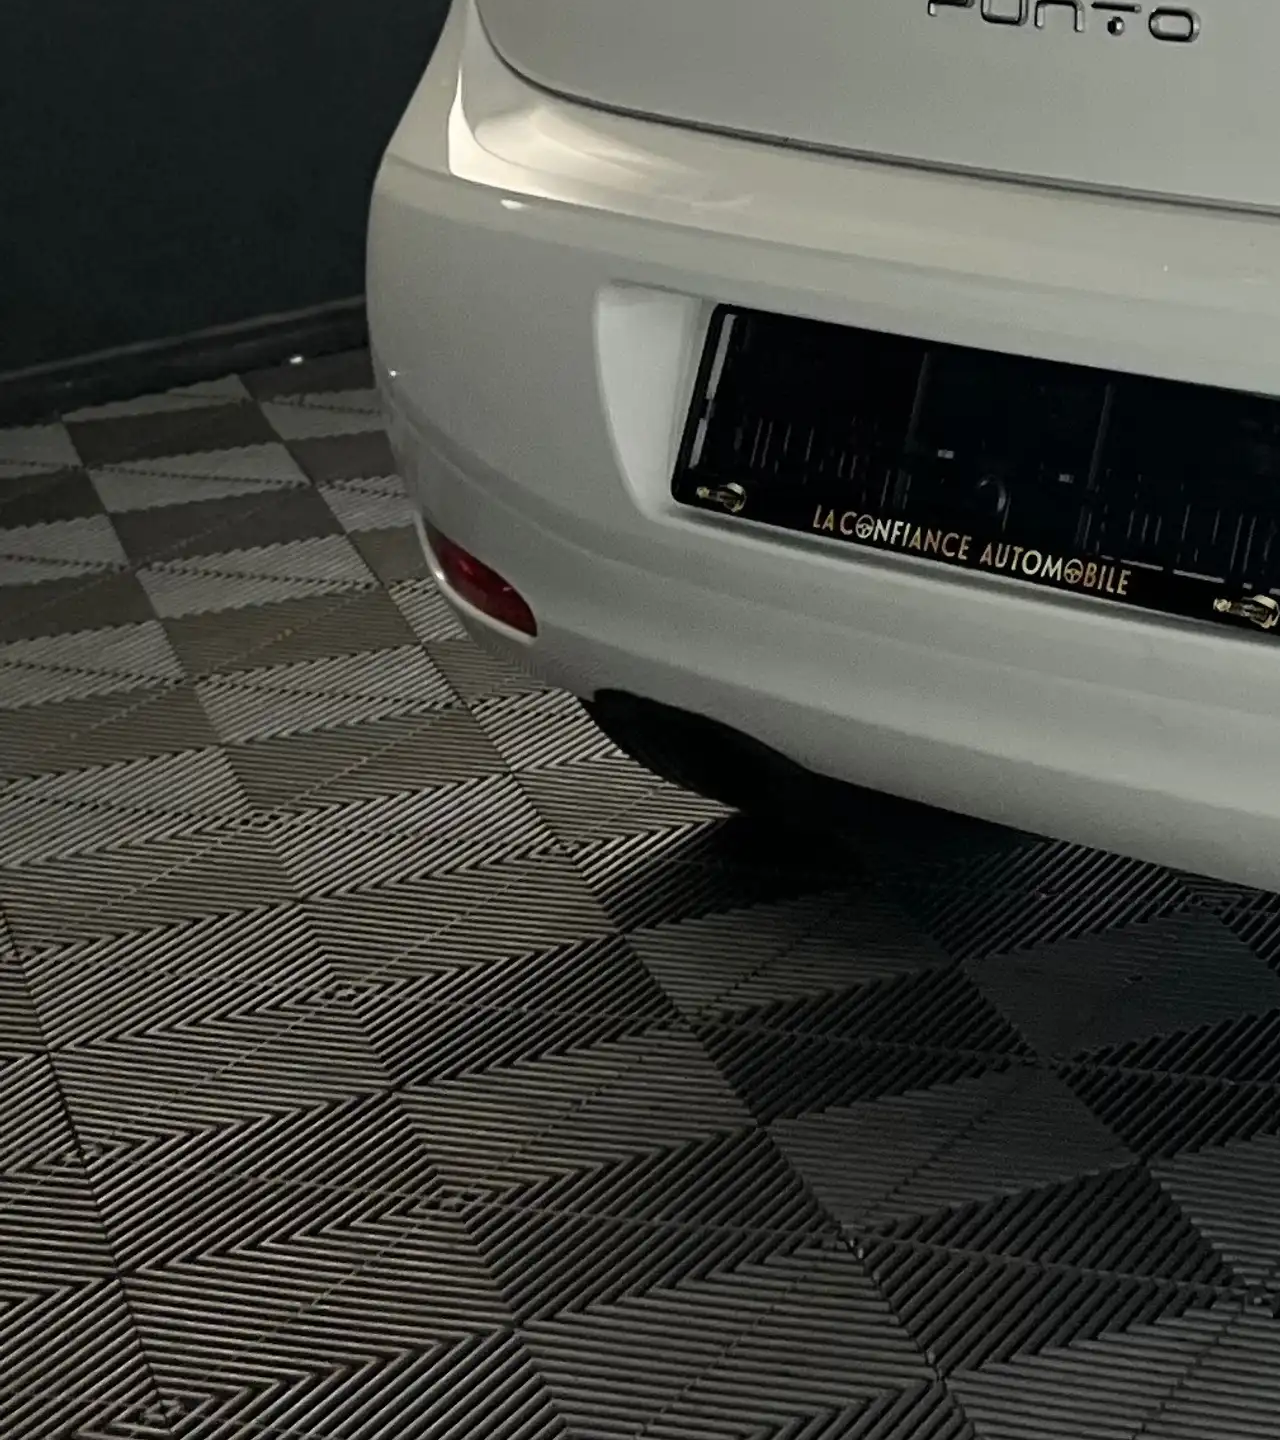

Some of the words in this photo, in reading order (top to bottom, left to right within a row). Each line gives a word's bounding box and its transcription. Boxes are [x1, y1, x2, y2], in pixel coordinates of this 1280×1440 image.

[812, 504, 835, 533] LA
[839, 511, 973, 561] CONFIANCE
[979, 541, 1133, 597] AUTOMOBILE
